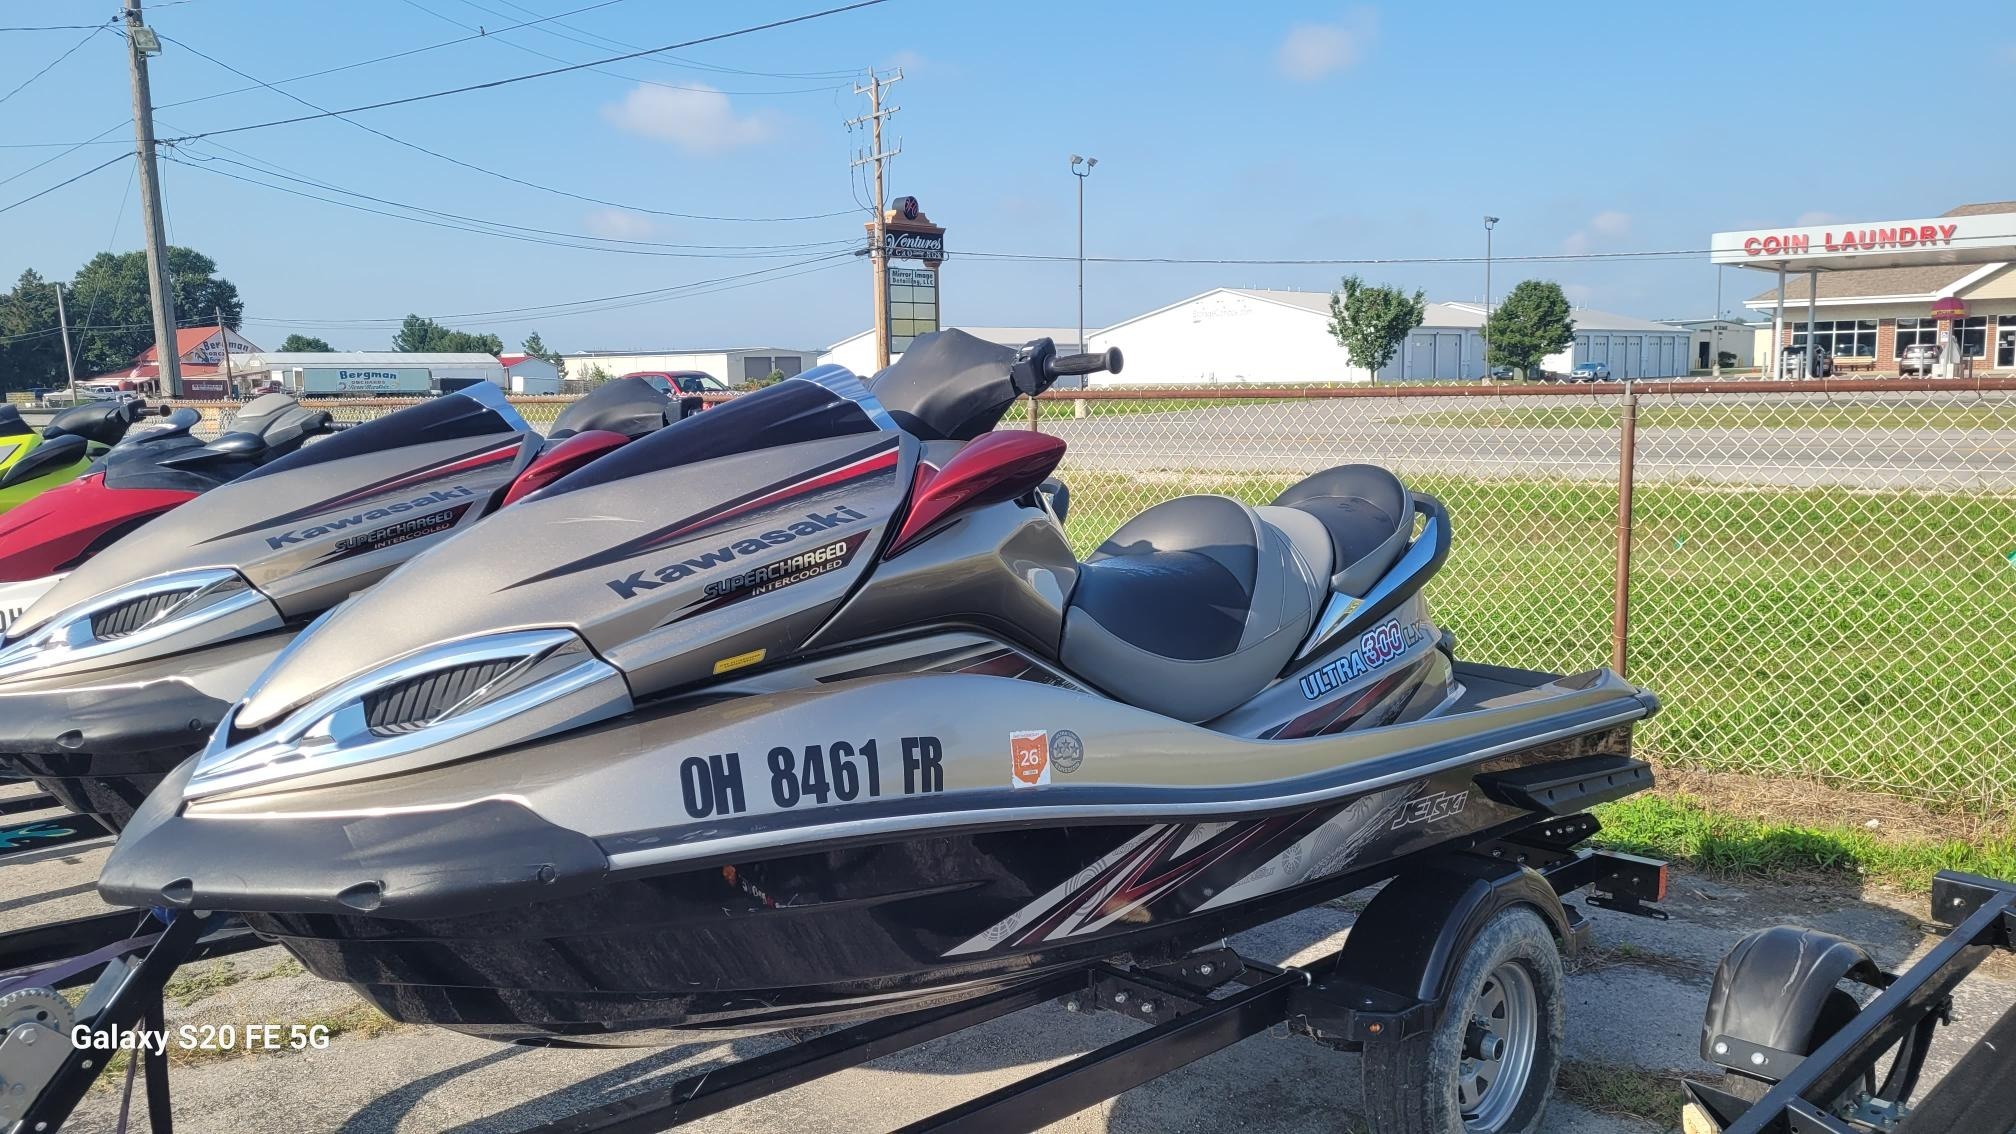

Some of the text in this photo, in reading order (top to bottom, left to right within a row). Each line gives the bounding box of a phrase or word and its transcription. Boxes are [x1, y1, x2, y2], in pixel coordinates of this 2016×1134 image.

[885, 233, 941, 250] Ventures
[1744, 224, 1957, 255] COIN LAUNDRY
[892, 270, 933, 280] Mirror Image
[203, 341, 249, 352] Berman
[340, 370, 397, 379] Bergman
[265, 486, 474, 550] Kawasaki
[334, 511, 454, 552] SUPERCHARGED
[374, 523, 450, 549] INTERCOOLED
[606, 505, 868, 600] Kawasaki
[703, 541, 847, 600] SUPERCHARGED
[752, 559, 842, 597] INTERCOOLED
[1299, 618, 1425, 701] ULTRA 300 LX
[1019, 749, 1039, 767] 26
[680, 736, 944, 818] OH 8461 FR
